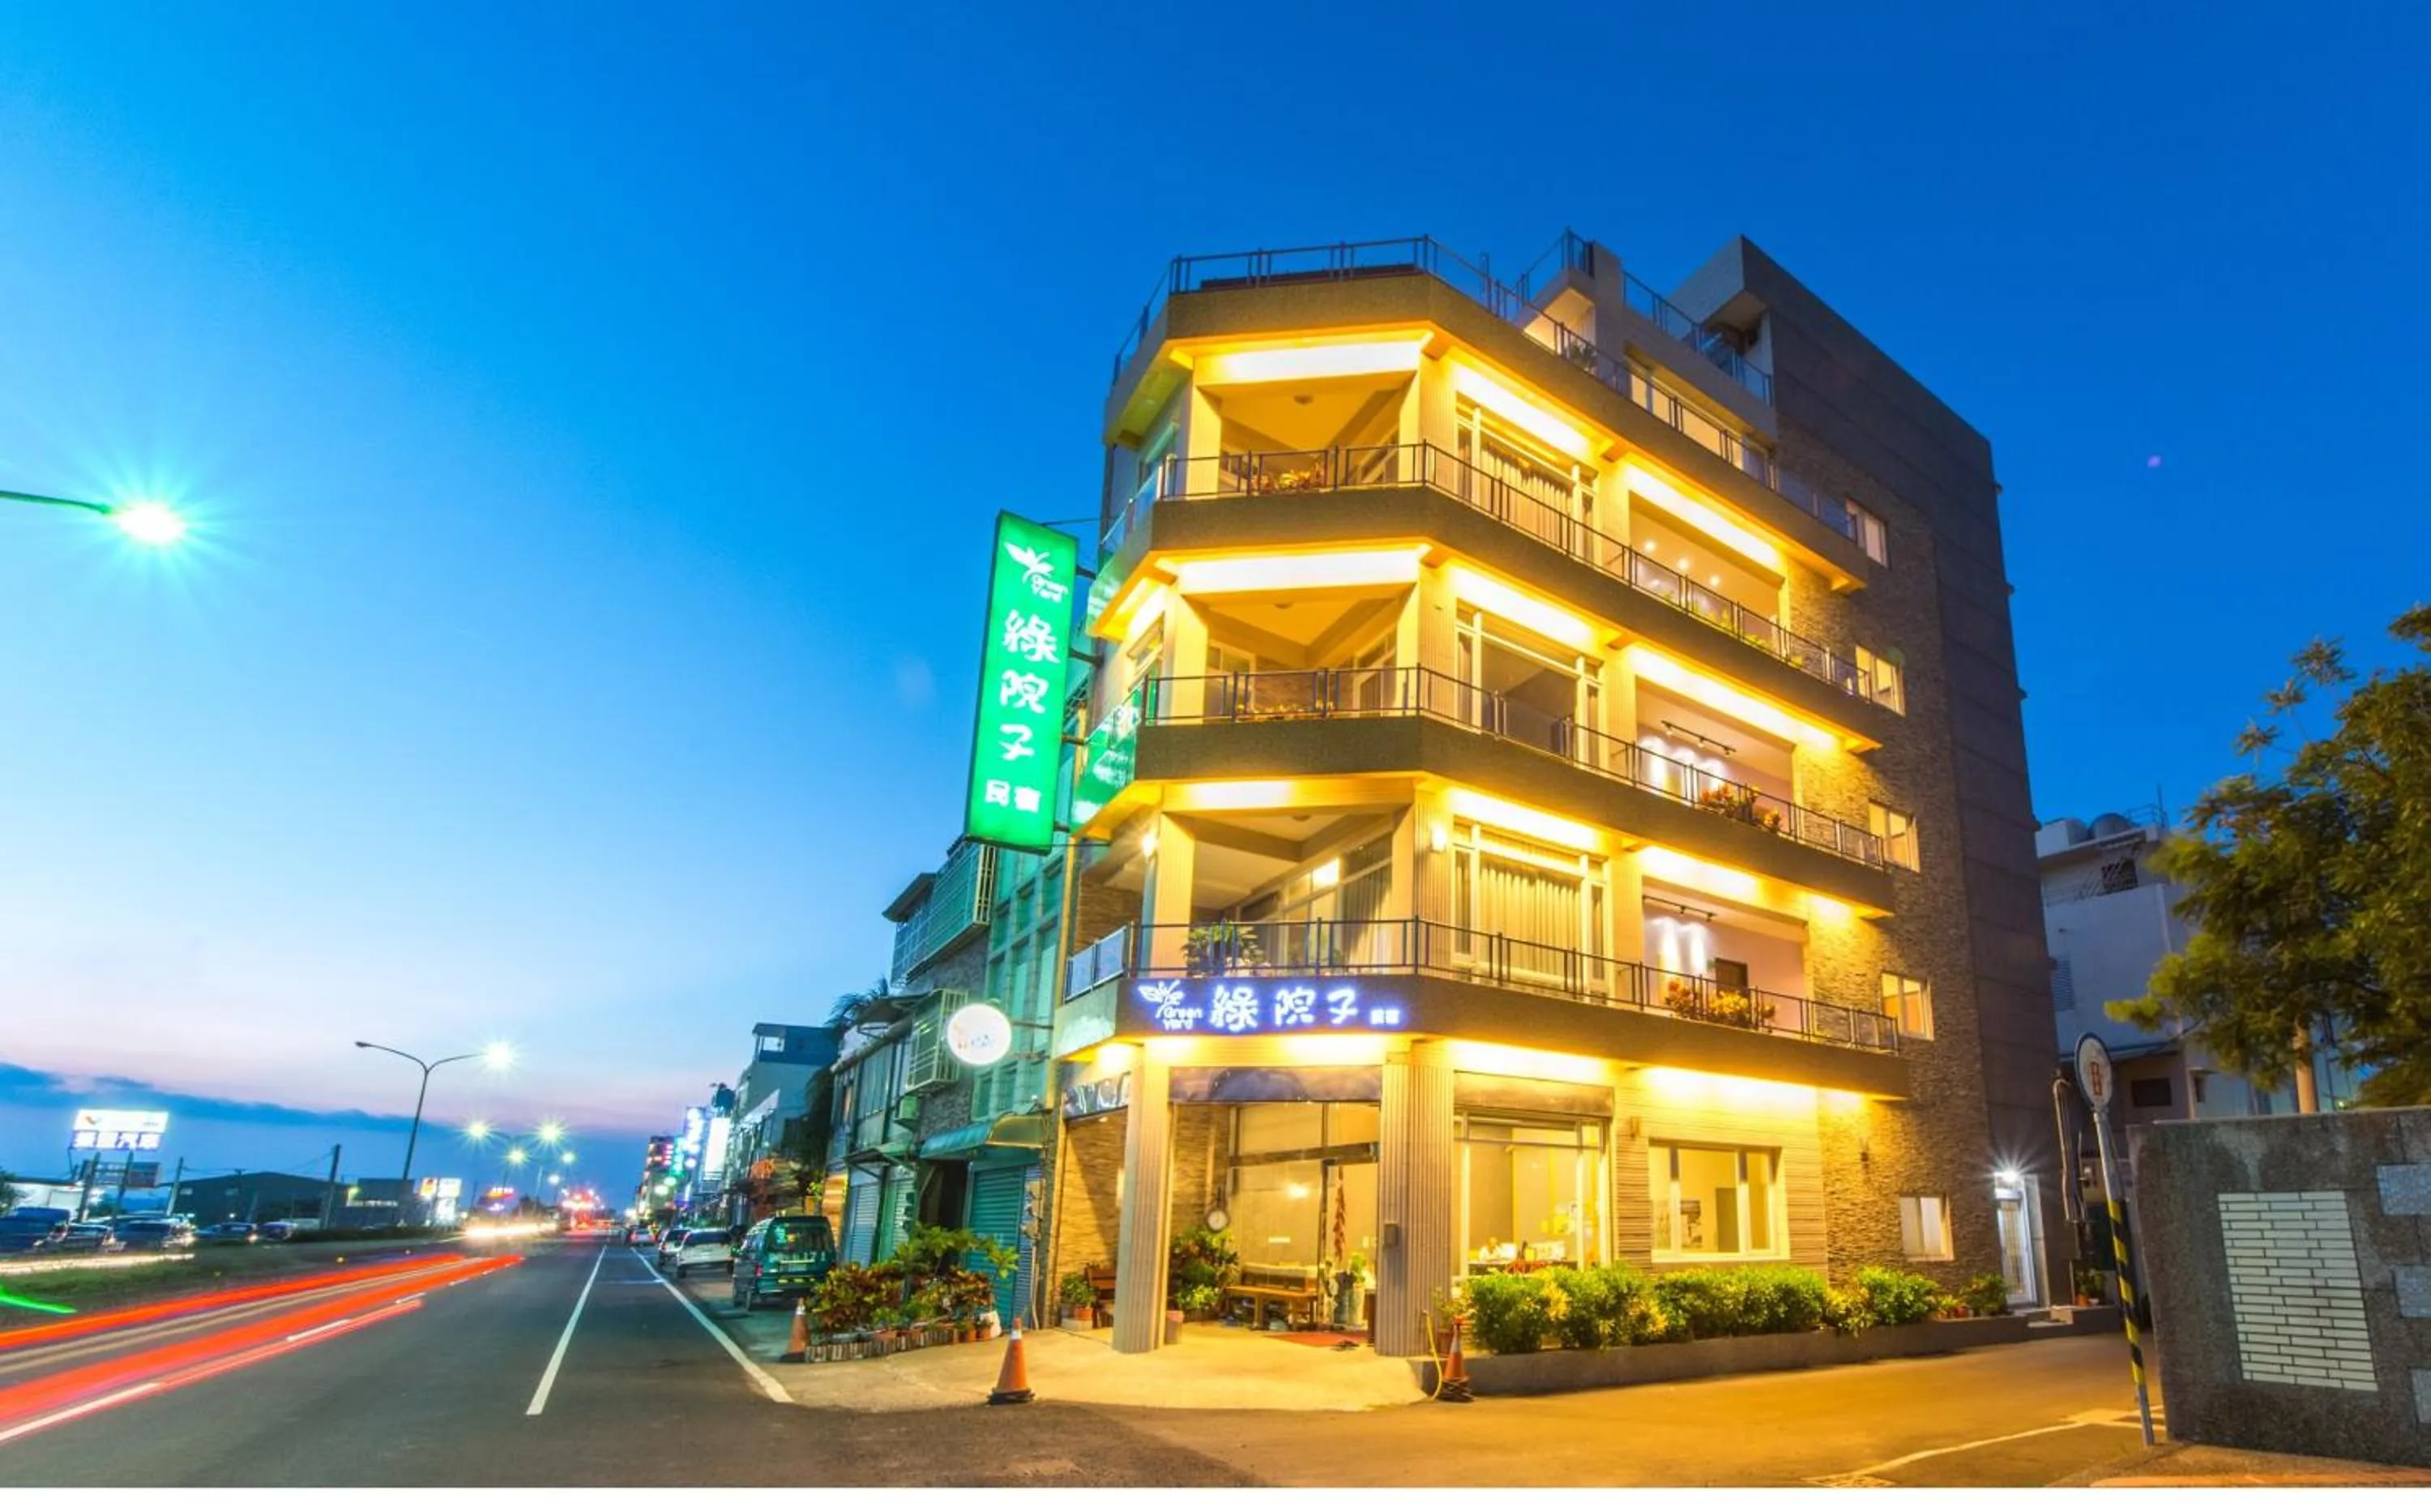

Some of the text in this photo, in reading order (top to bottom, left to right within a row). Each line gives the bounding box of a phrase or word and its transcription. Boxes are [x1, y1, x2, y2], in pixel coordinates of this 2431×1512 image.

[1000, 609, 1060, 761] 綠院子
[1210, 984, 1358, 1031] 綠院子
